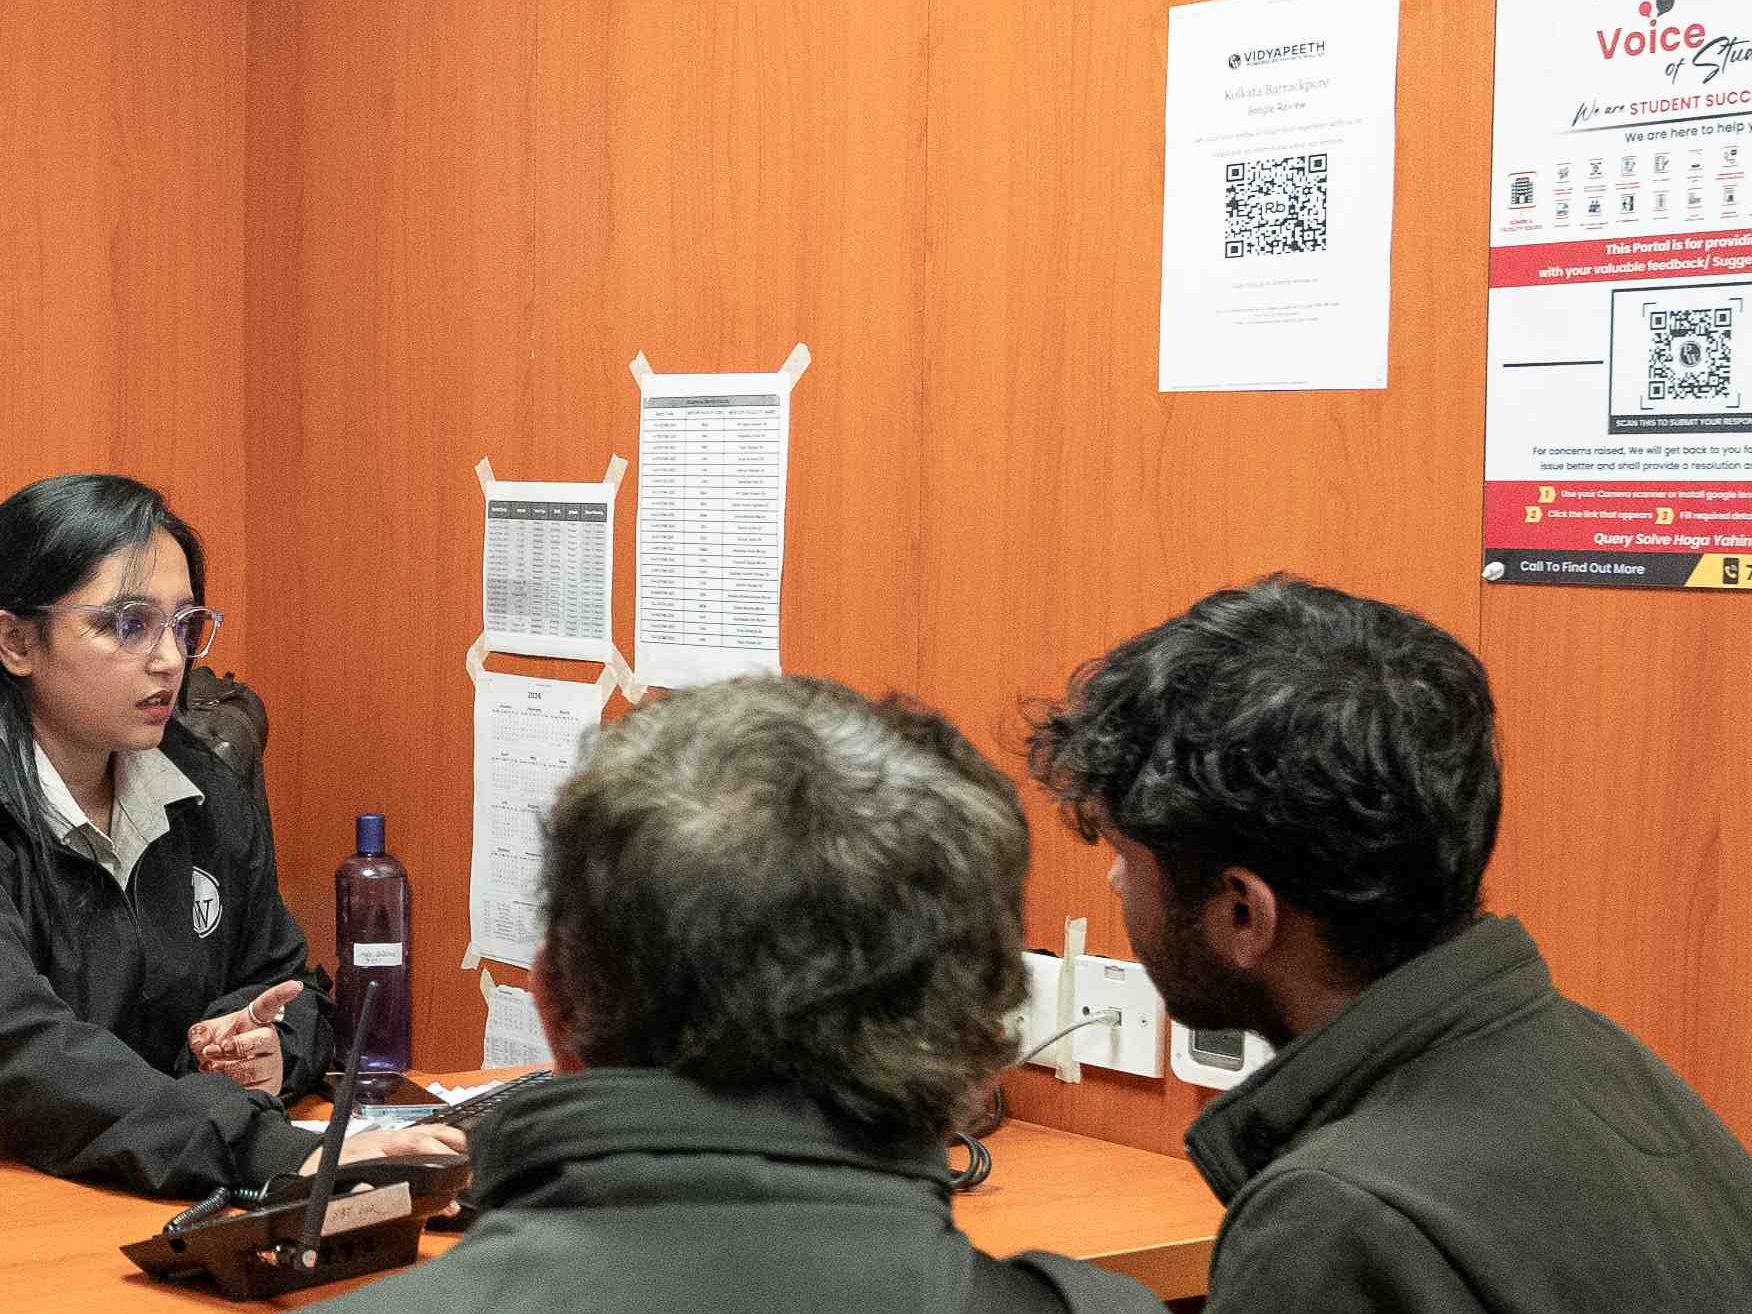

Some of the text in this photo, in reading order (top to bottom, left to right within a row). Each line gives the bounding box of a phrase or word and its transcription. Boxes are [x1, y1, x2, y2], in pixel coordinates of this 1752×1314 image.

[1596, 19, 1707, 60] Voice
[1244, 41, 1325, 62] VIDYAPEETH
[1665, 58, 1686, 85] of
[1571, 99, 1600, 127] We
[1605, 104, 1626, 115] are
[1630, 95, 1701, 116] STUDENT
[1624, 131, 1644, 144] We
[1646, 130, 1666, 141] are
[1671, 126, 1698, 139] here
[1701, 125, 1714, 136] to
[1716, 122, 1744, 137] help
[1605, 243, 1631, 255] This
[1633, 239, 1671, 254] Portal
[1672, 238, 1683, 250] is
[1684, 237, 1703, 250] for
[1538, 266, 1563, 278] with
[1565, 266, 1592, 279] your
[1594, 260, 1645, 274] valuable
[1647, 254, 1711, 271] feedback/
[1593, 533, 1633, 547] Query
[1635, 534, 1671, 547] Solve
[1673, 534, 1710, 548] Hoga
[1712, 534, 1752, 547] Yahin
[1520, 561, 1543, 573] Call
[1545, 562, 1560, 573] To
[1561, 562, 1586, 573] Find
[1589, 562, 1610, 574] Out
[1612, 563, 1645, 575] More
